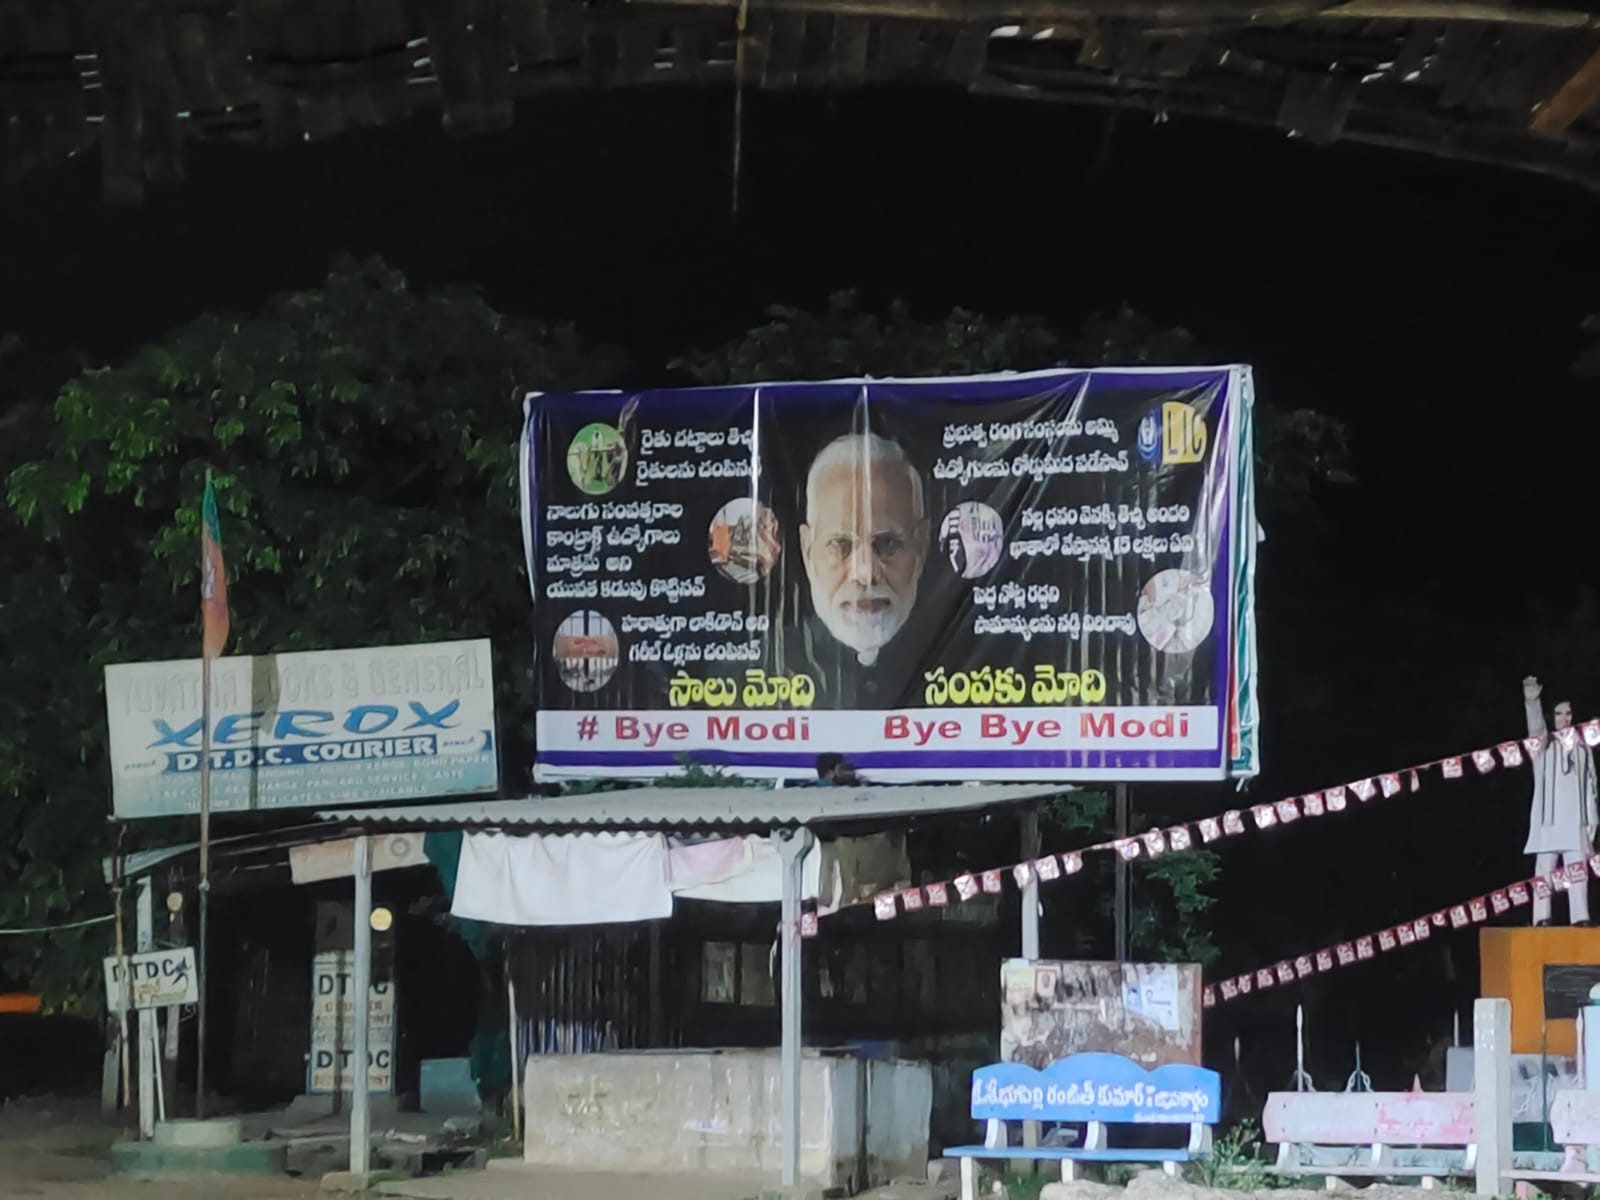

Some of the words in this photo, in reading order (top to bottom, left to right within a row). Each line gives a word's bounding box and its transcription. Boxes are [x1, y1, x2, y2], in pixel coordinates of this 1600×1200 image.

[640, 428, 671, 455] రైతు
[635, 460, 696, 486] రైతులను
[547, 501, 600, 521] నాలుగు
[606, 523, 681, 553] ఉద్యోగాలు
[1113, 535, 1131, 555] 15
[605, 555, 633, 572] అని
[547, 579, 598, 599] యువత
[601, 578, 647, 601] కడుపు
[669, 668, 737, 708] సాలు
[924, 664, 1026, 705] సంపకు
[146, 698, 463, 750] XEROX
[615, 715, 690, 747] Bye
[706, 715, 810, 742] Modi
[883, 714, 962, 746] Bye
[979, 713, 1062, 745] Bye
[1080, 712, 1190, 739] Modi
[302, 736, 435, 762] COURIER
[319, 973, 388, 995] DTC
